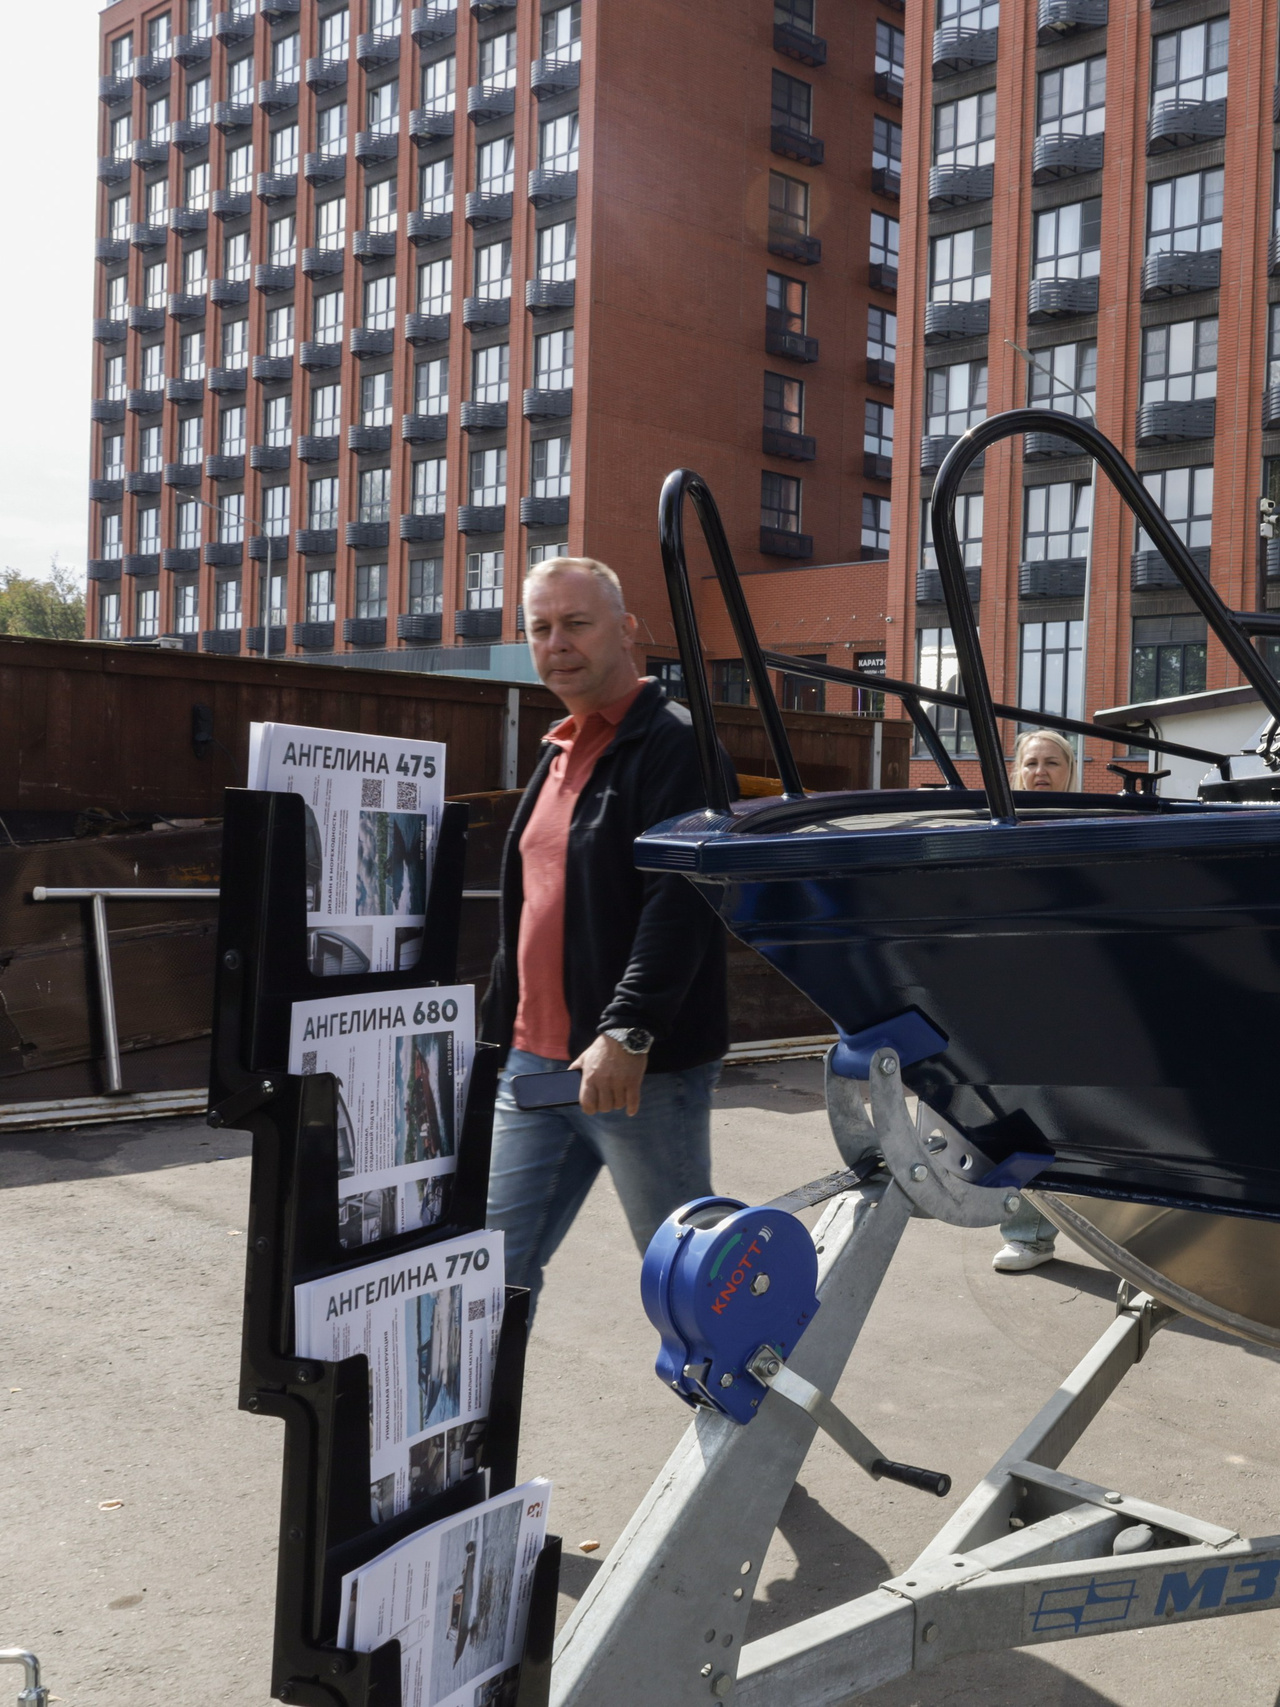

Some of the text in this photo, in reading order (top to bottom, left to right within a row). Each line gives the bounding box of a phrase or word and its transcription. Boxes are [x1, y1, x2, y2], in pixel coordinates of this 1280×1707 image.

[858, 658, 886, 667] КАРАТЭ
[282, 741, 436, 778] АНГЕЛИНА 475
[302, 998, 459, 1042] АНГЕЛИНА 680
[325, 1261, 438, 1322] АНГЕЛИНА
[444, 1247, 490, 1280] 770
[710, 1239, 764, 1316] KNOTT
